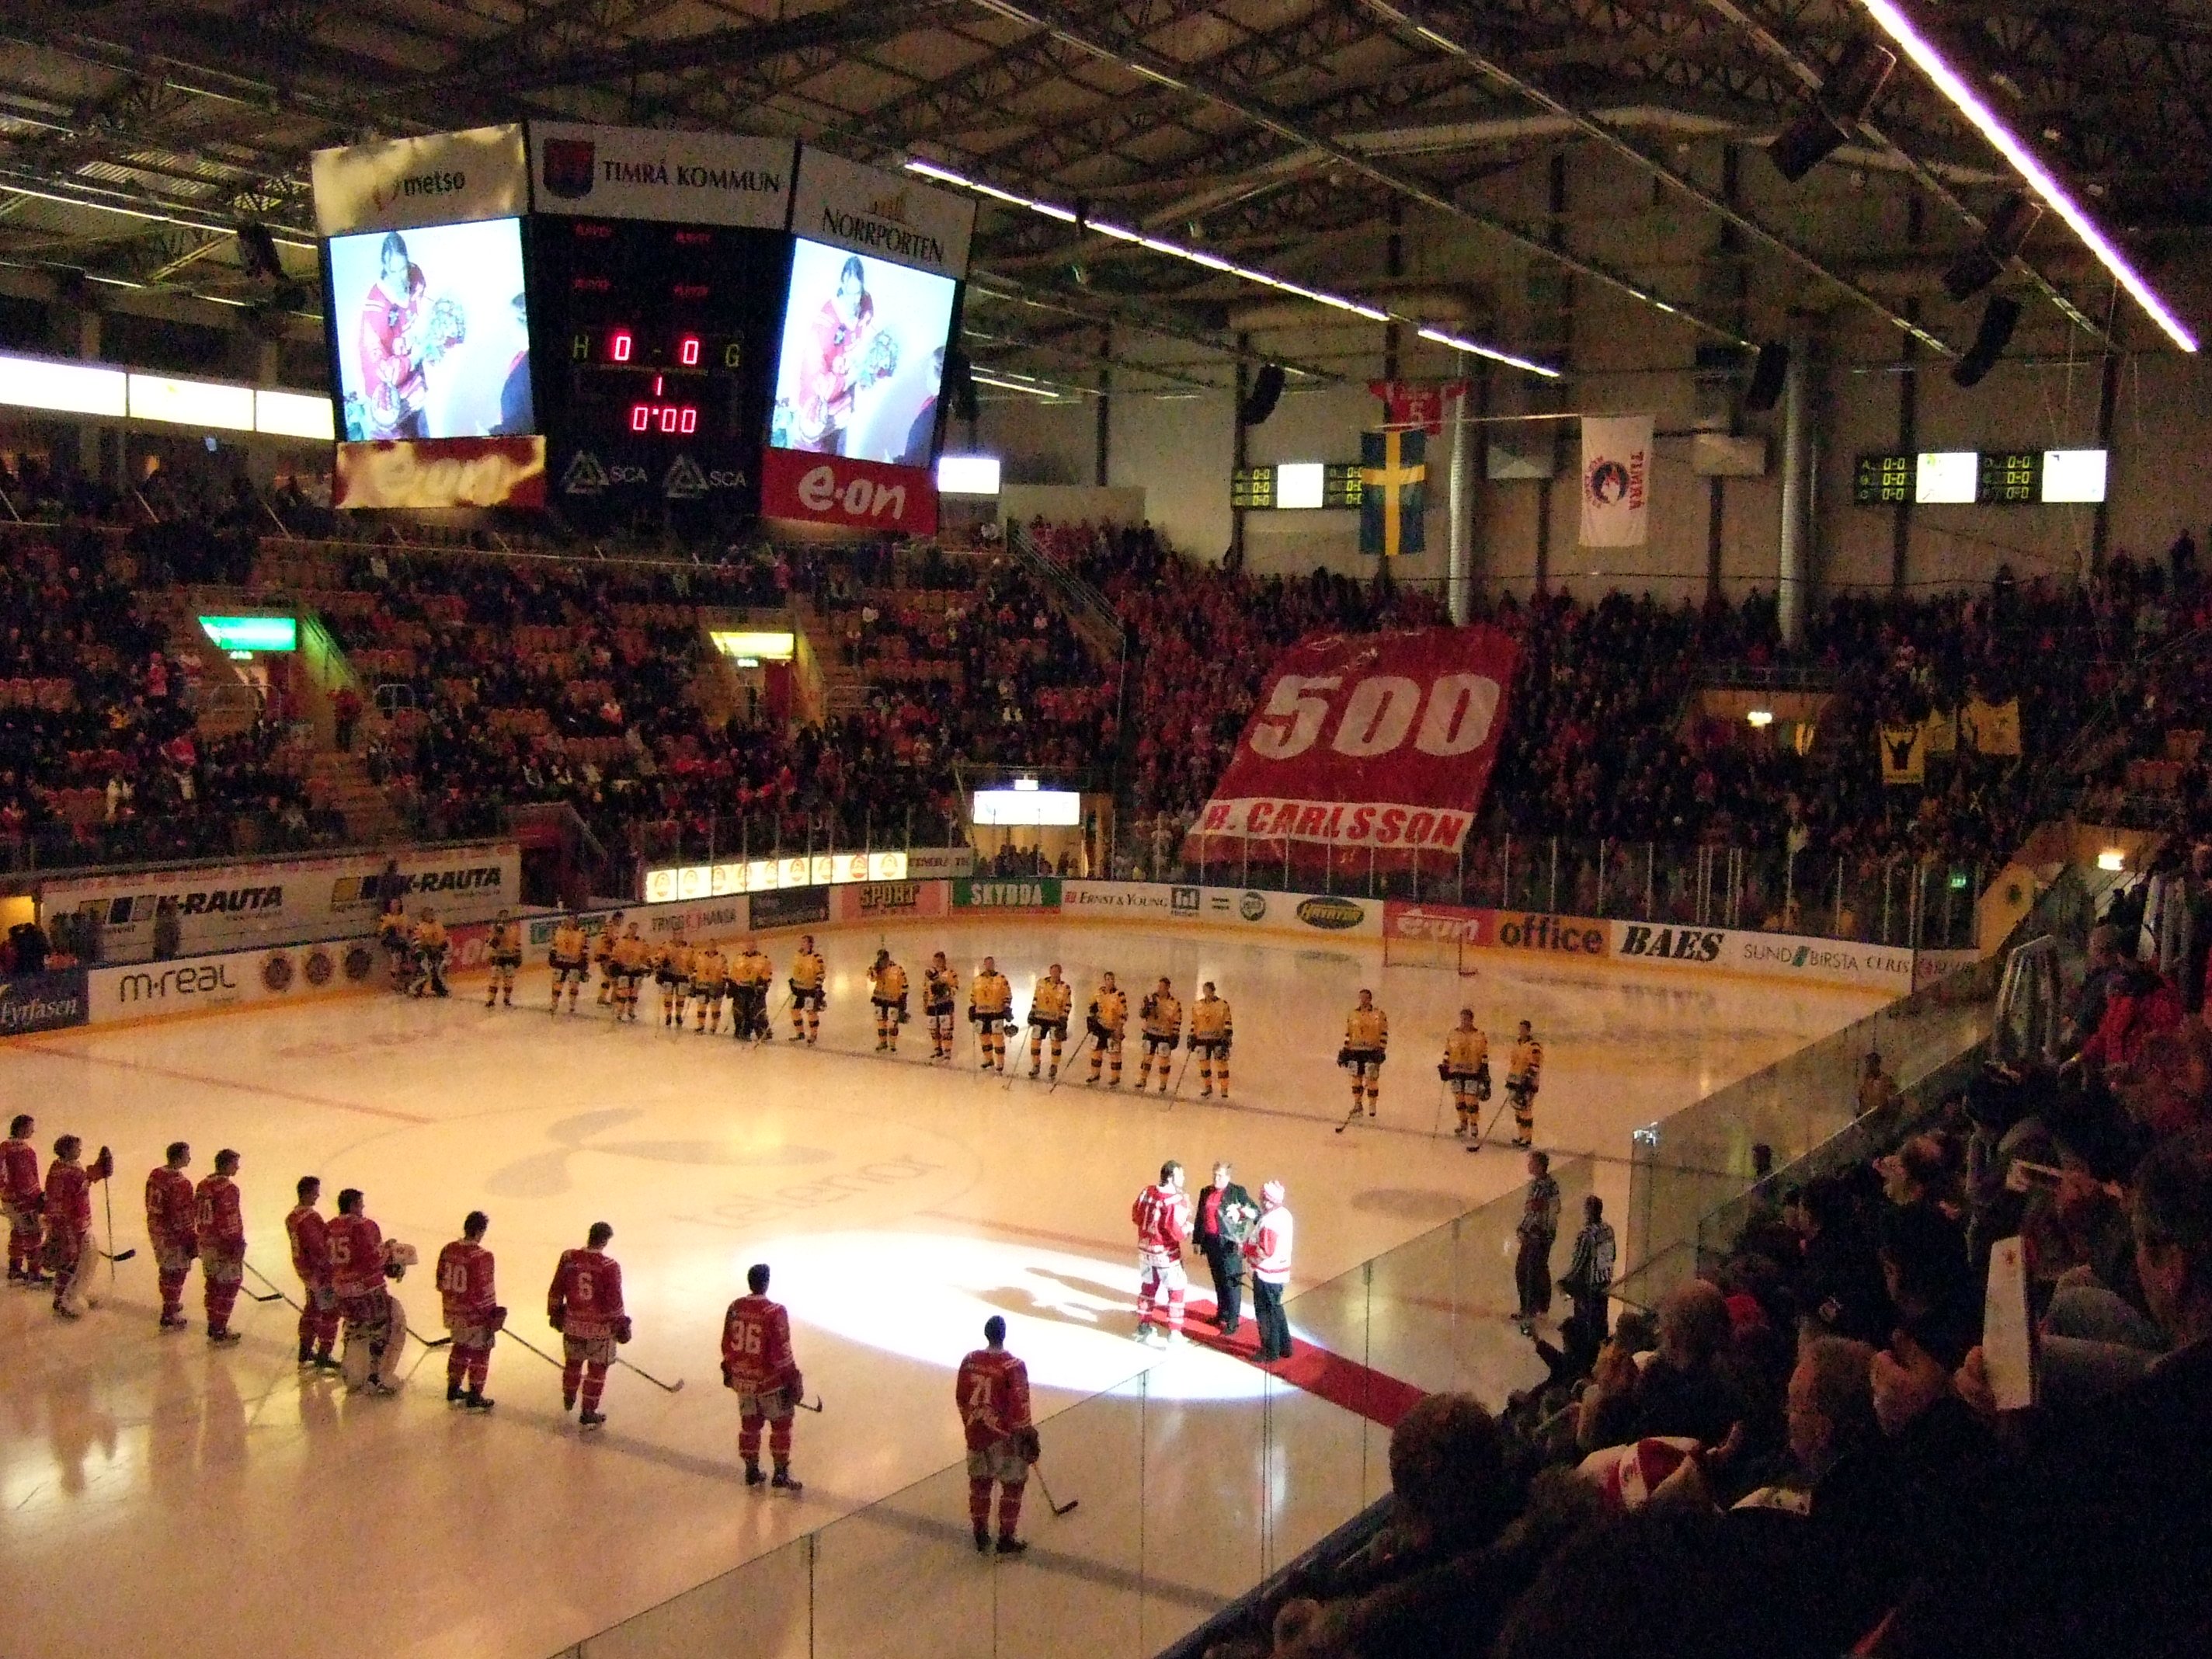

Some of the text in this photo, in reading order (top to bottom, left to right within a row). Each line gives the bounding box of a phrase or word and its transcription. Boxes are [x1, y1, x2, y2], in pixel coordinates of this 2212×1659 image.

[404, 171, 465, 196] metso
[676, 165, 781, 193] KOMMUN
[822, 207, 945, 266] NORRPORTEN
[614, 336, 631, 362] 0
[683, 339, 700, 366] 0
[709, 470, 746, 488] SCA
[1250, 673, 1501, 760] 500
[1247, 802, 1463, 847] CARLSSON
[1499, 914, 1603, 954] office
[1620, 925, 1724, 962] BAES
[1810, 948, 1859, 972] BIRSTA
